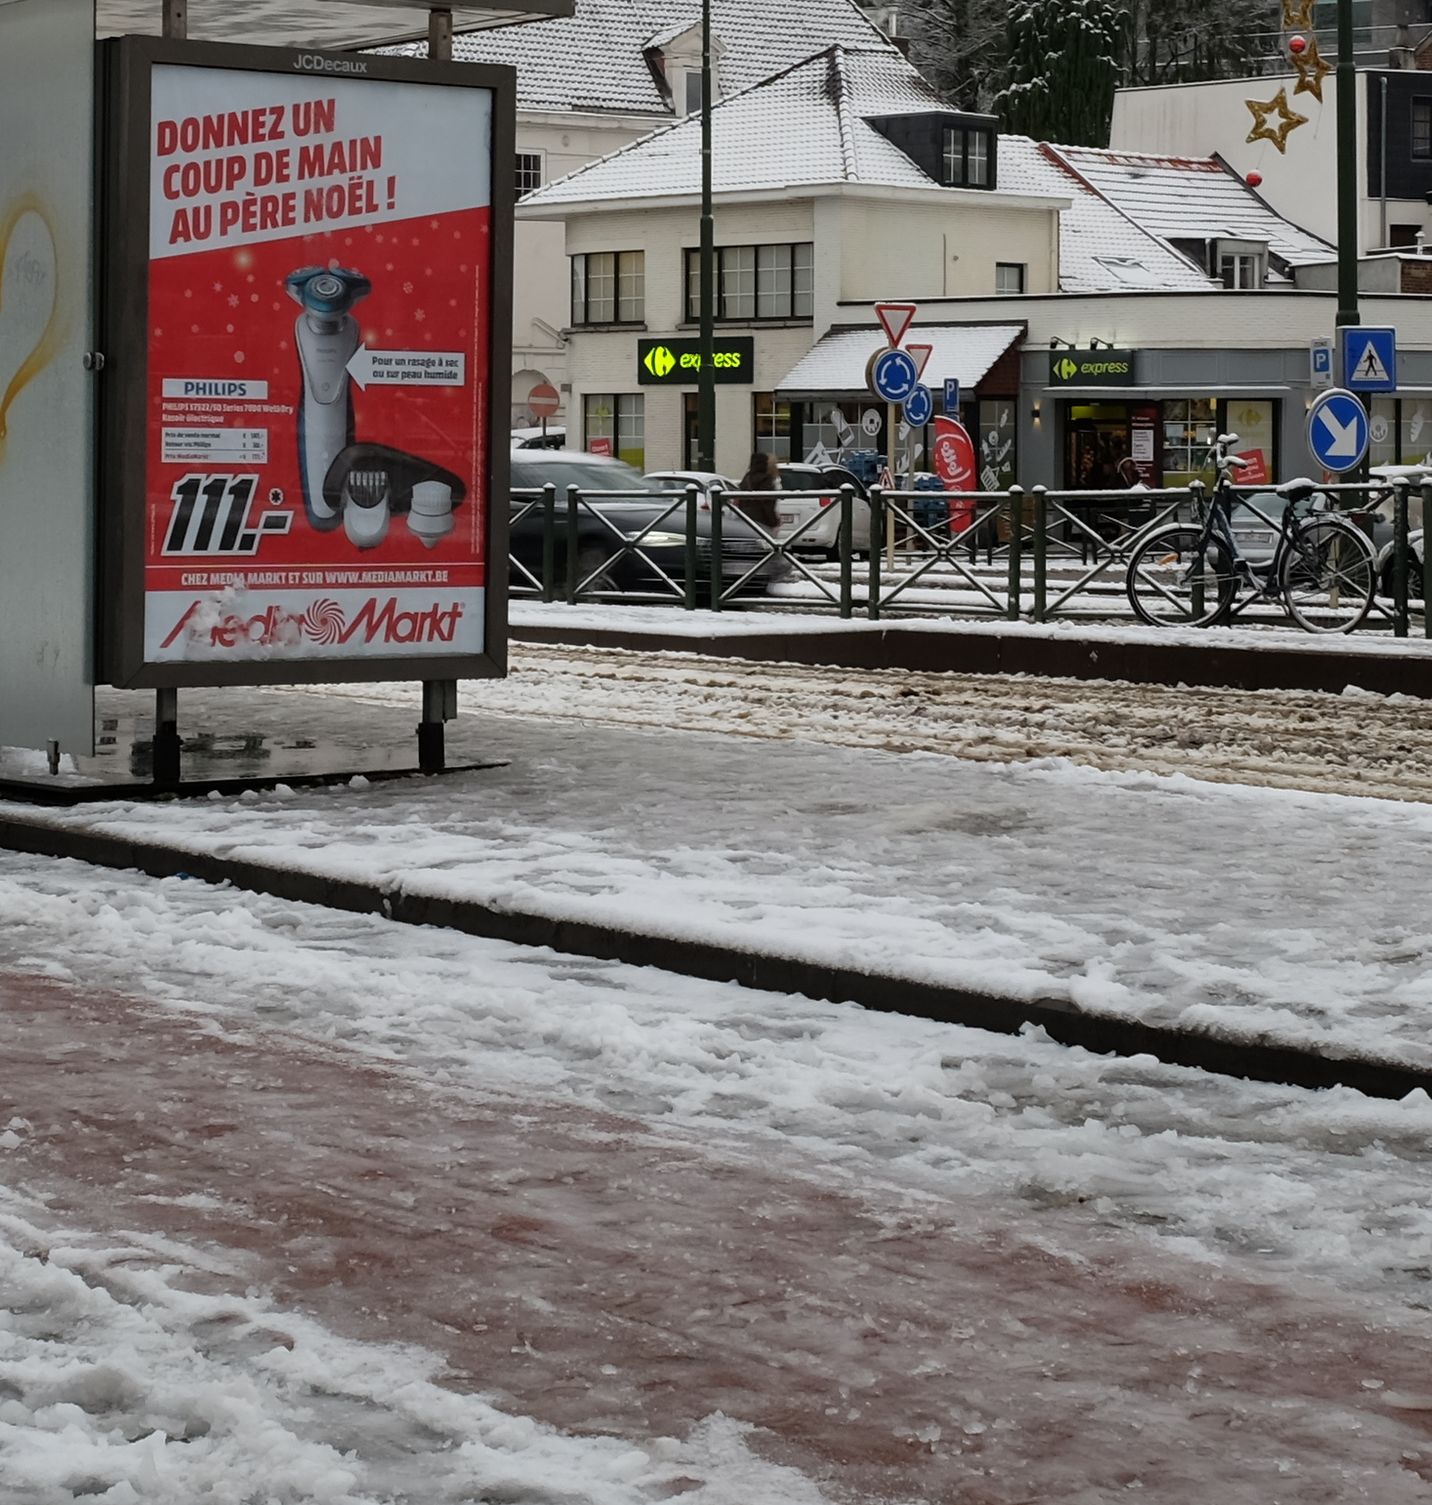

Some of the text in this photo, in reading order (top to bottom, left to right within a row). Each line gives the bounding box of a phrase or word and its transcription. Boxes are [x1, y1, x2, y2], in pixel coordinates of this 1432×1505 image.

[293, 54, 368, 74] JCDecaux
[157, 98, 336, 157] DONNEZ UN
[163, 135, 382, 200] COUP DE MAIN
[169, 175, 396, 245] AU PÈRE NOËL !
[372, 356, 393, 366] Pour
[394, 358, 406, 366] un
[407, 358, 436, 368] rasage
[445, 359, 459, 367] sec
[679, 352, 741, 373] exess
[1080, 362, 1129, 376] express
[1316, 353, 1326, 369] P
[372, 370, 459, 380] ou sur peau humide
[184, 382, 247, 396] PHILIPS
[946, 381, 955, 400] P
[181, 570, 449, 586] CHEZ MEDIA MARKT ET SUR WWW.MEDIAMARKT.BE
[336, 597, 463, 645] Markt
